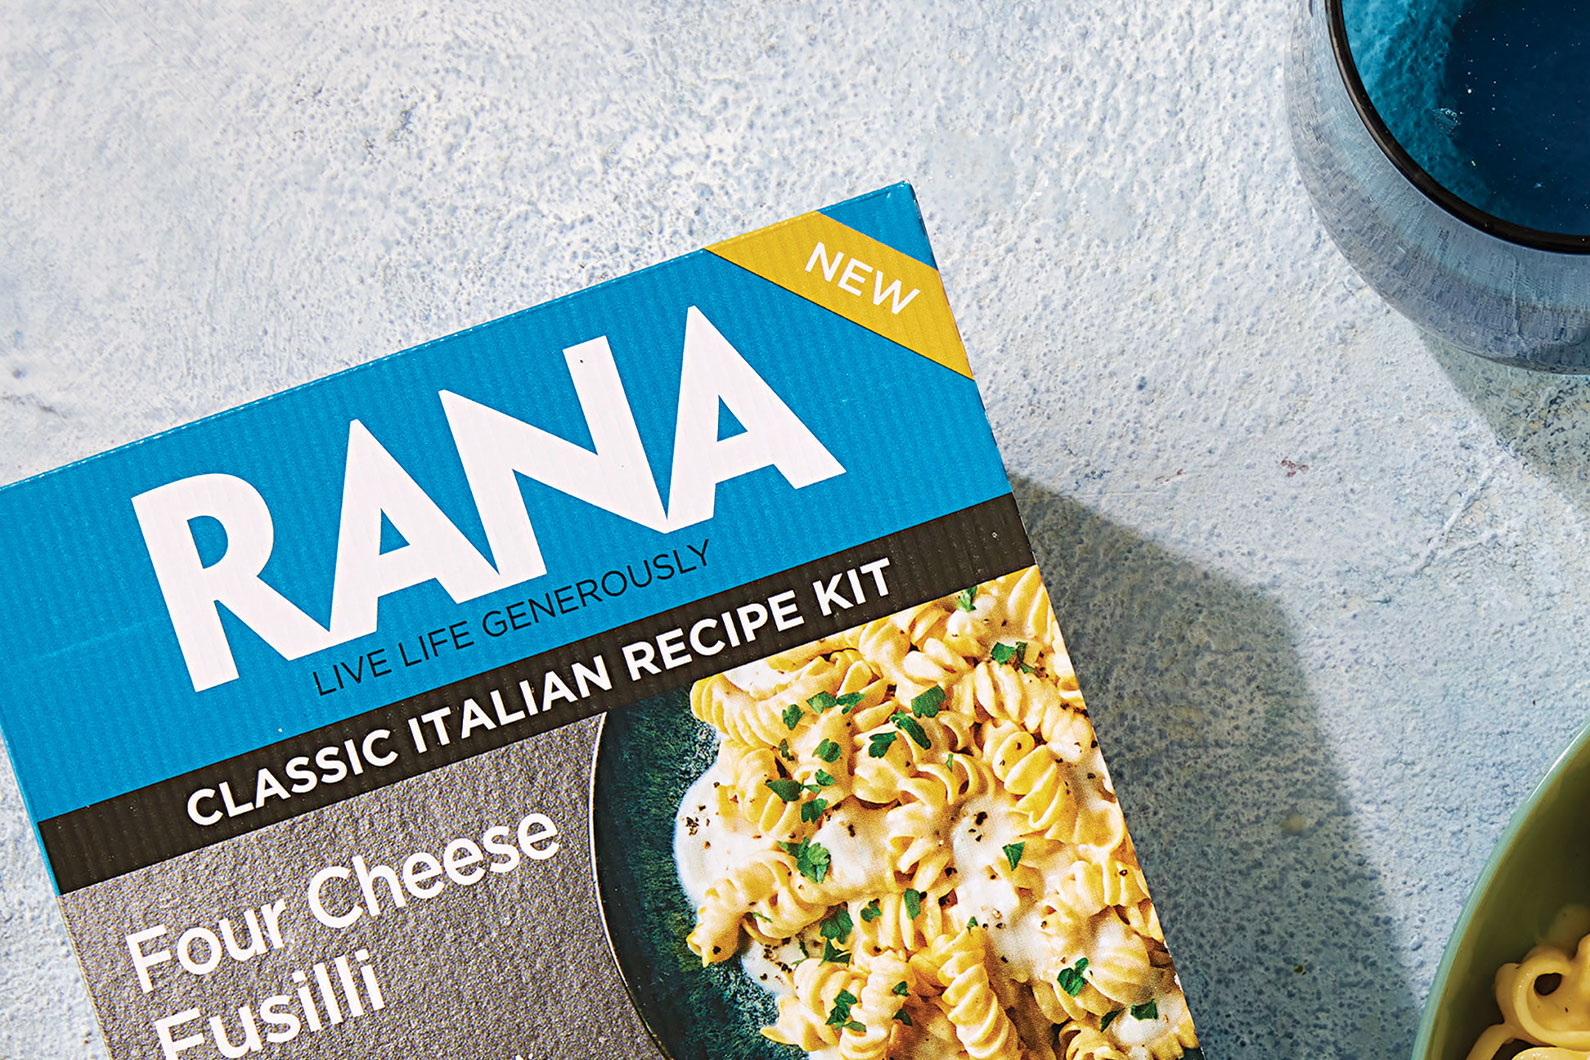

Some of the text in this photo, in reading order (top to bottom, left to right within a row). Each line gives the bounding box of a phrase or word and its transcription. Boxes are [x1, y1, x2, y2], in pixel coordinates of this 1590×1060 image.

[805, 240, 920, 315] NEW
[131, 305, 846, 692] RANA
[186, 558, 895, 827] CLASSIC ITALIAN RECIPE KIT
[312, 540, 712, 697] LIVE LIFE GENEROUSLY
[126, 813, 560, 993] Four Cheese
